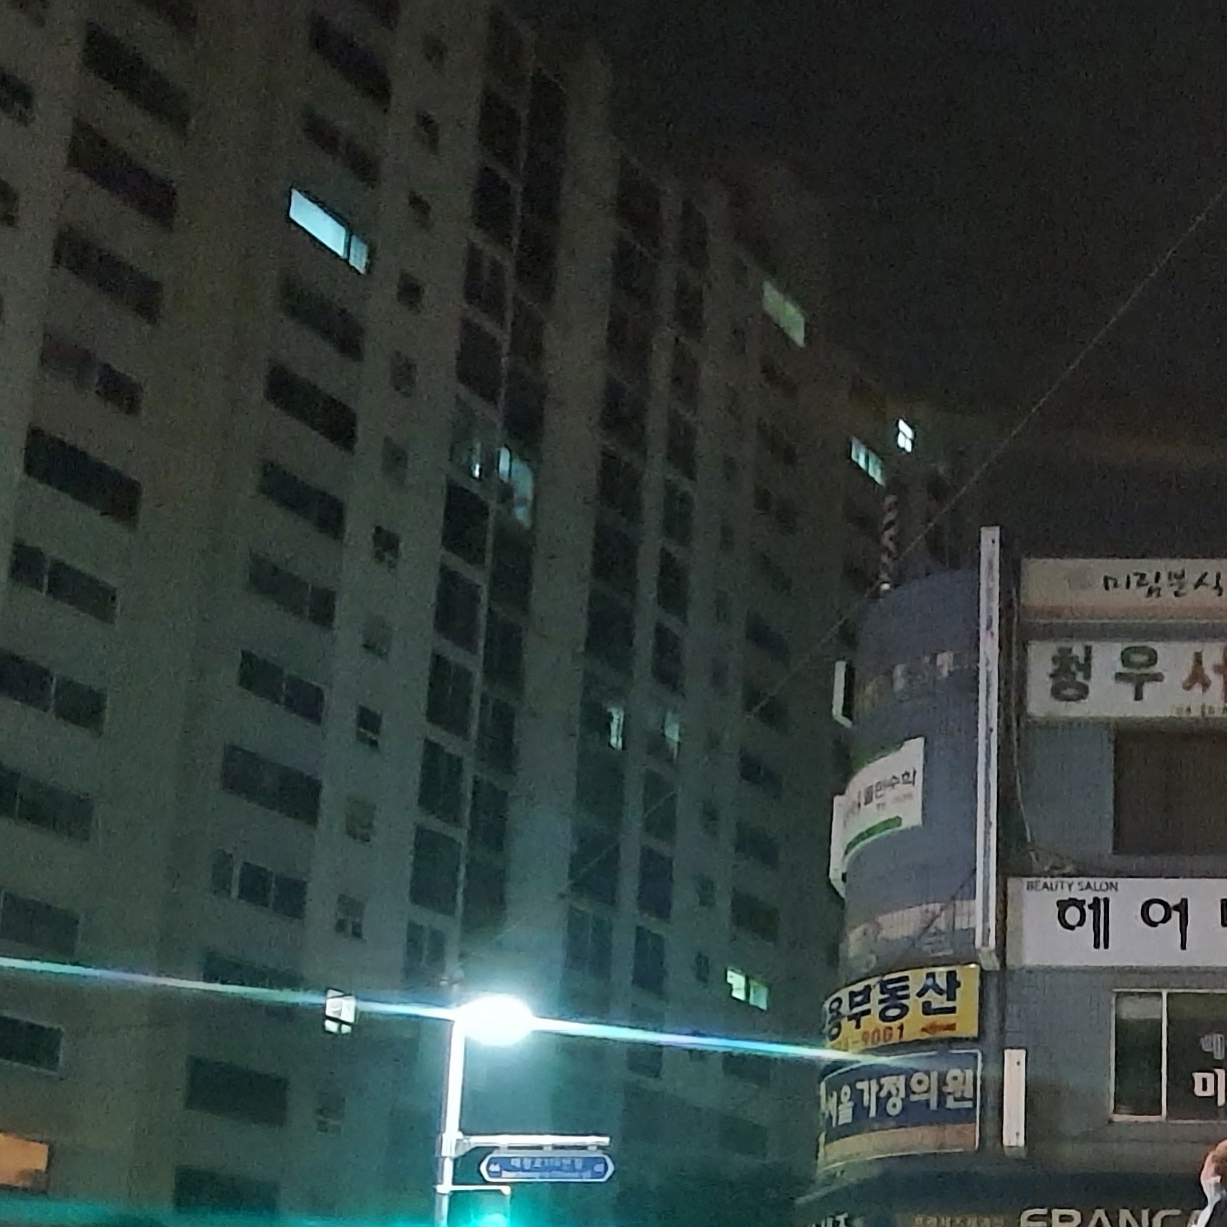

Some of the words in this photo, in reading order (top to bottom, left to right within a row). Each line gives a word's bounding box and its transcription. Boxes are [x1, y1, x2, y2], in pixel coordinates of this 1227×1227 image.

[1102, 568, 1225, 598] 미림분식
[1026, 880, 1075, 892] BEAUTY
[1077, 881, 1119, 892] SALON
